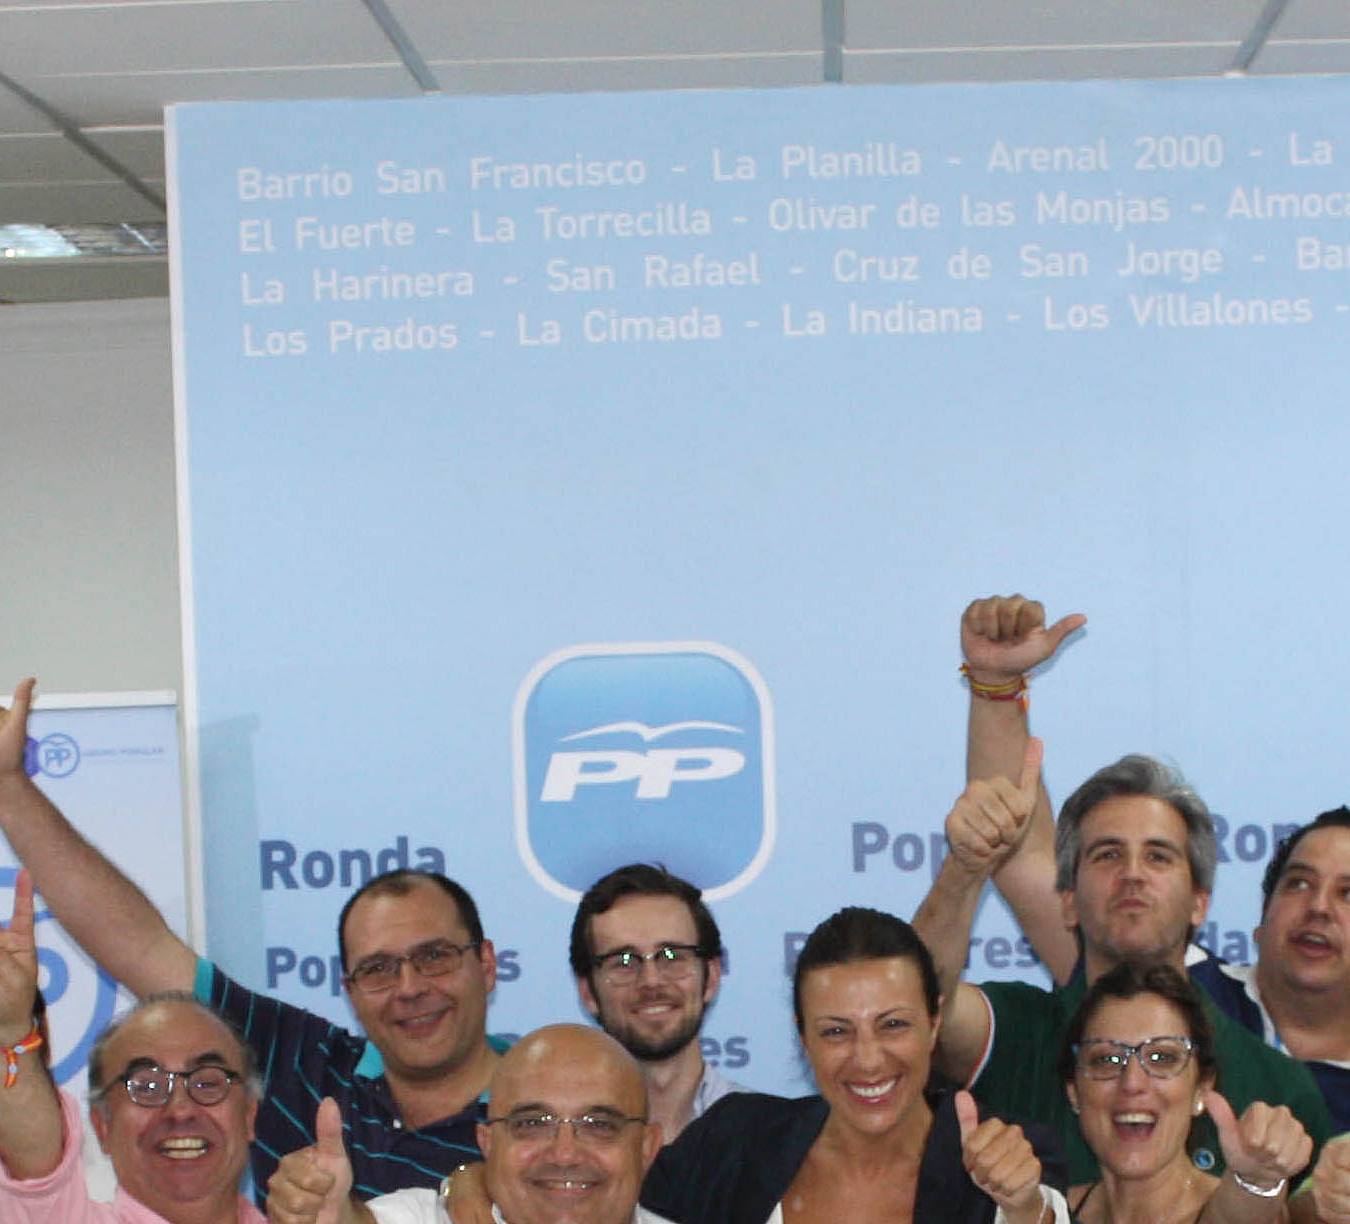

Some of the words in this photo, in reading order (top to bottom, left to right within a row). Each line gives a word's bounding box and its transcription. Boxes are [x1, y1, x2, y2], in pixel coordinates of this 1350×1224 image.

[236, 164, 354, 201] Barrio
[375, 159, 446, 195] San
[469, 152, 647, 190] Francisco
[712, 148, 758, 182] La
[781, 141, 922, 178] Planilla
[987, 137, 1110, 172] Arenal
[1134, 132, 1224, 170] 2000
[1288, 130, 1334, 166] La
[238, 218, 276, 253] El
[295, 215, 416, 250] Fuerte
[472, 210, 516, 243] La
[535, 202, 712, 240] Torrecilla
[768, 197, 877, 232] Olivar
[896, 194, 941, 229] de
[960, 194, 1016, 227] las
[1036, 190, 1171, 232] Monjas
[240, 271, 286, 306] La
[312, 265, 474, 301] Harinera
[545, 257, 615, 293] San
[644, 251, 761, 288] Rafael
[833, 248, 921, 283] Cruz
[947, 246, 992, 280] de
[1019, 243, 1089, 278] San
[1117, 242, 1224, 282] Jorge
[242, 323, 308, 358] Los
[328, 316, 459, 353] Prados
[517, 312, 563, 346] La
[583, 307, 723, 343] Cimada
[781, 302, 827, 338] La
[848, 300, 984, 334] Indiana
[1043, 295, 1111, 331] Los
[1129, 292, 1314, 327] Villalones
[538, 746, 746, 803] PP
